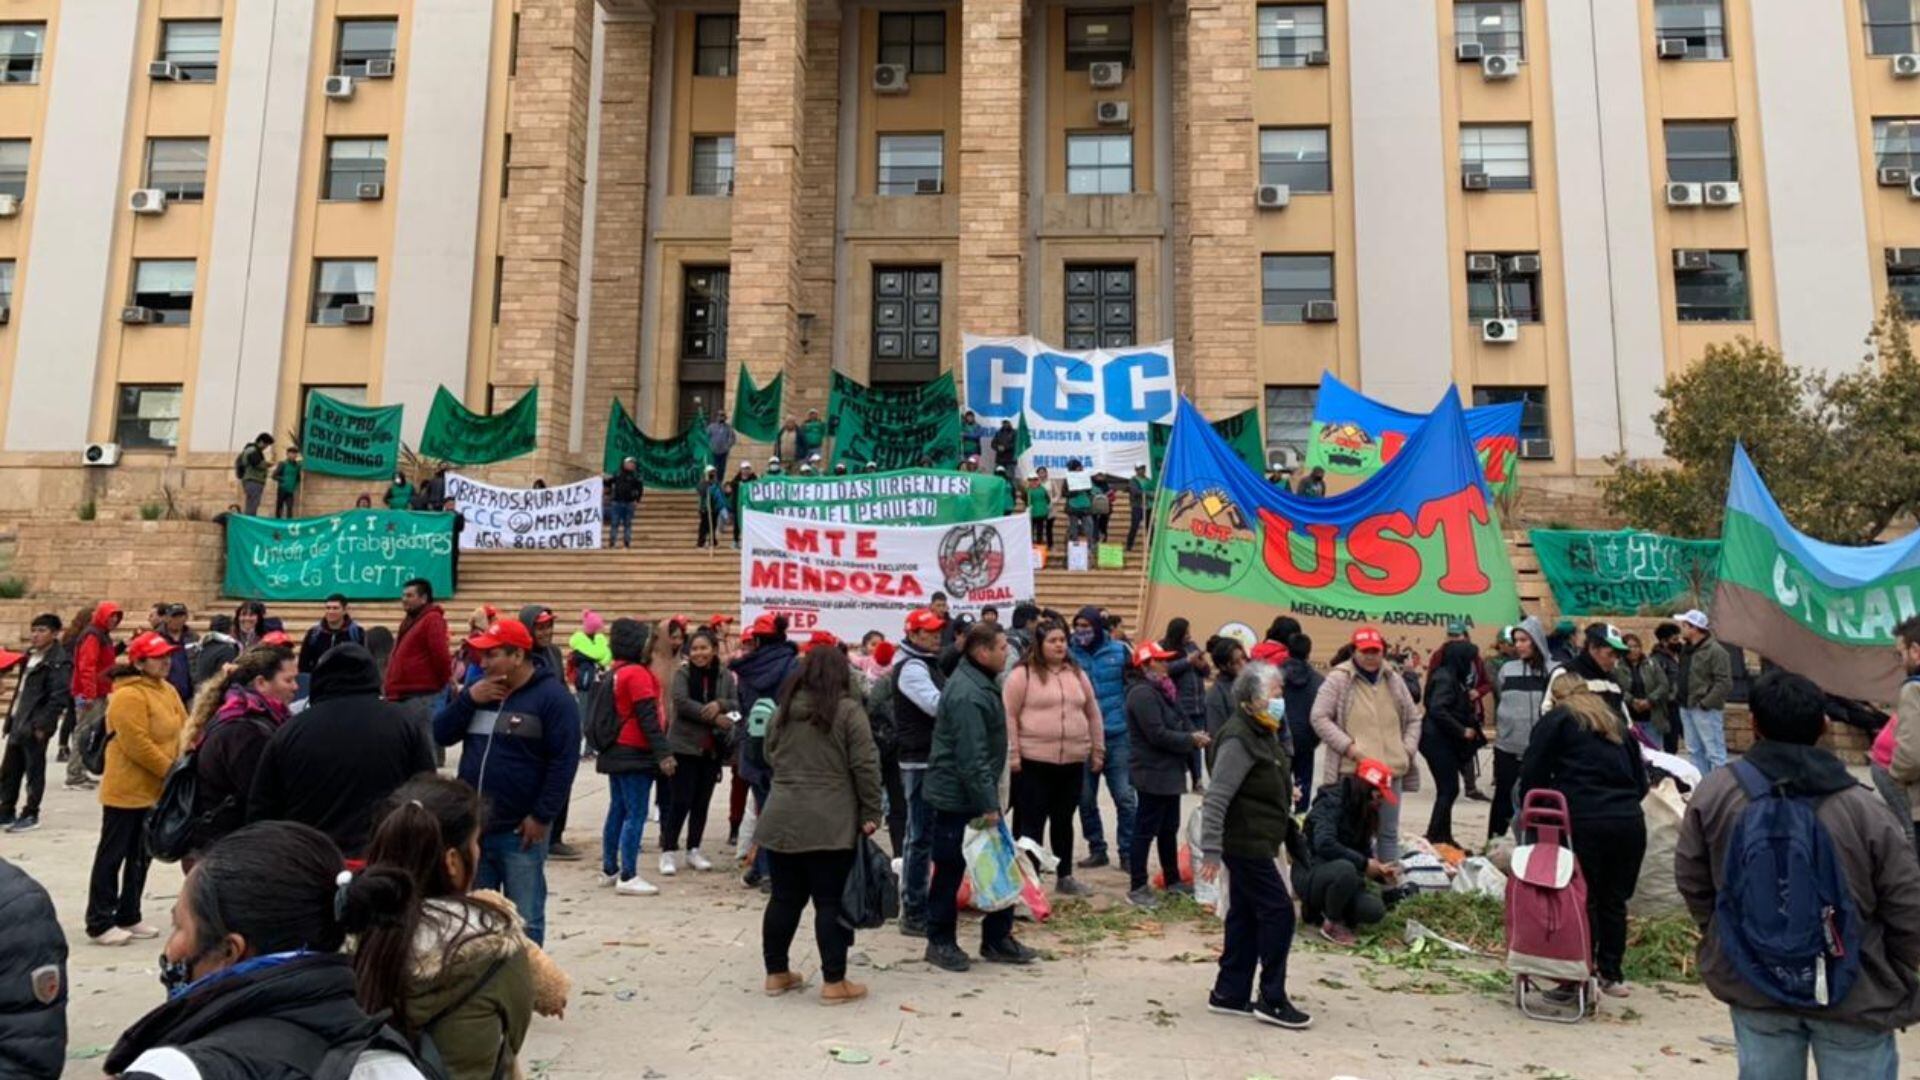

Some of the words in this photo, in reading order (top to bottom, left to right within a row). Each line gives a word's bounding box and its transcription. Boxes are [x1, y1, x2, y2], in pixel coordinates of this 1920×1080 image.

[966, 345, 1174, 423] CCC
[1031, 430, 1081, 442] LASISTA
[1088, 432, 1095, 442] Y
[449, 478, 521, 511] OBREROS
[524, 486, 592, 512] RURALES
[751, 483, 783, 501] POR
[789, 479, 870, 501] MEDIDAS
[876, 477, 970, 496] URGENTES
[461, 505, 503, 529] CCC
[535, 507, 600, 532] MENDOZA
[829, 504, 849, 523] EL
[785, 528, 878, 558] MTE
[1190, 518, 1232, 543] UST
[1257, 483, 1490, 597] UST
[309, 533, 331, 559] de
[266, 564, 289, 588] de
[300, 560, 323, 587] la
[751, 560, 924, 597] MENDOZA
[967, 587, 1014, 602] RURAL
[1290, 601, 1367, 623] MENDOZA
[1382, 610, 1475, 629] ARGENTINA
